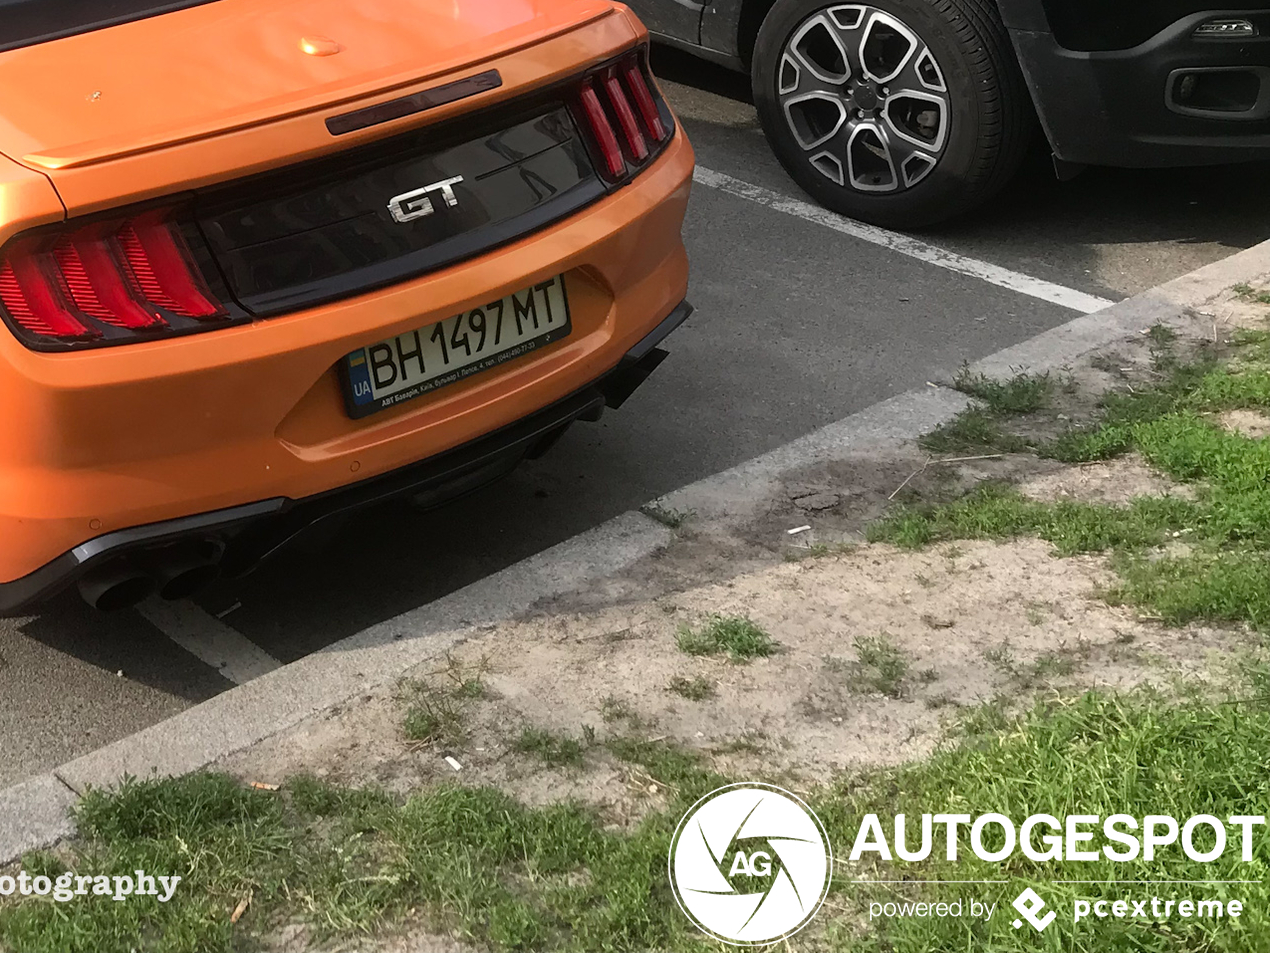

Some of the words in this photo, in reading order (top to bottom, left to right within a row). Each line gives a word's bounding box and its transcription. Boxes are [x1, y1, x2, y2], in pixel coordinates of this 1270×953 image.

[387, 175, 464, 223] GT
[368, 329, 426, 390] BH
[430, 298, 504, 365] 1497
[511, 279, 555, 336] MT
[354, 380, 371, 397] UA
